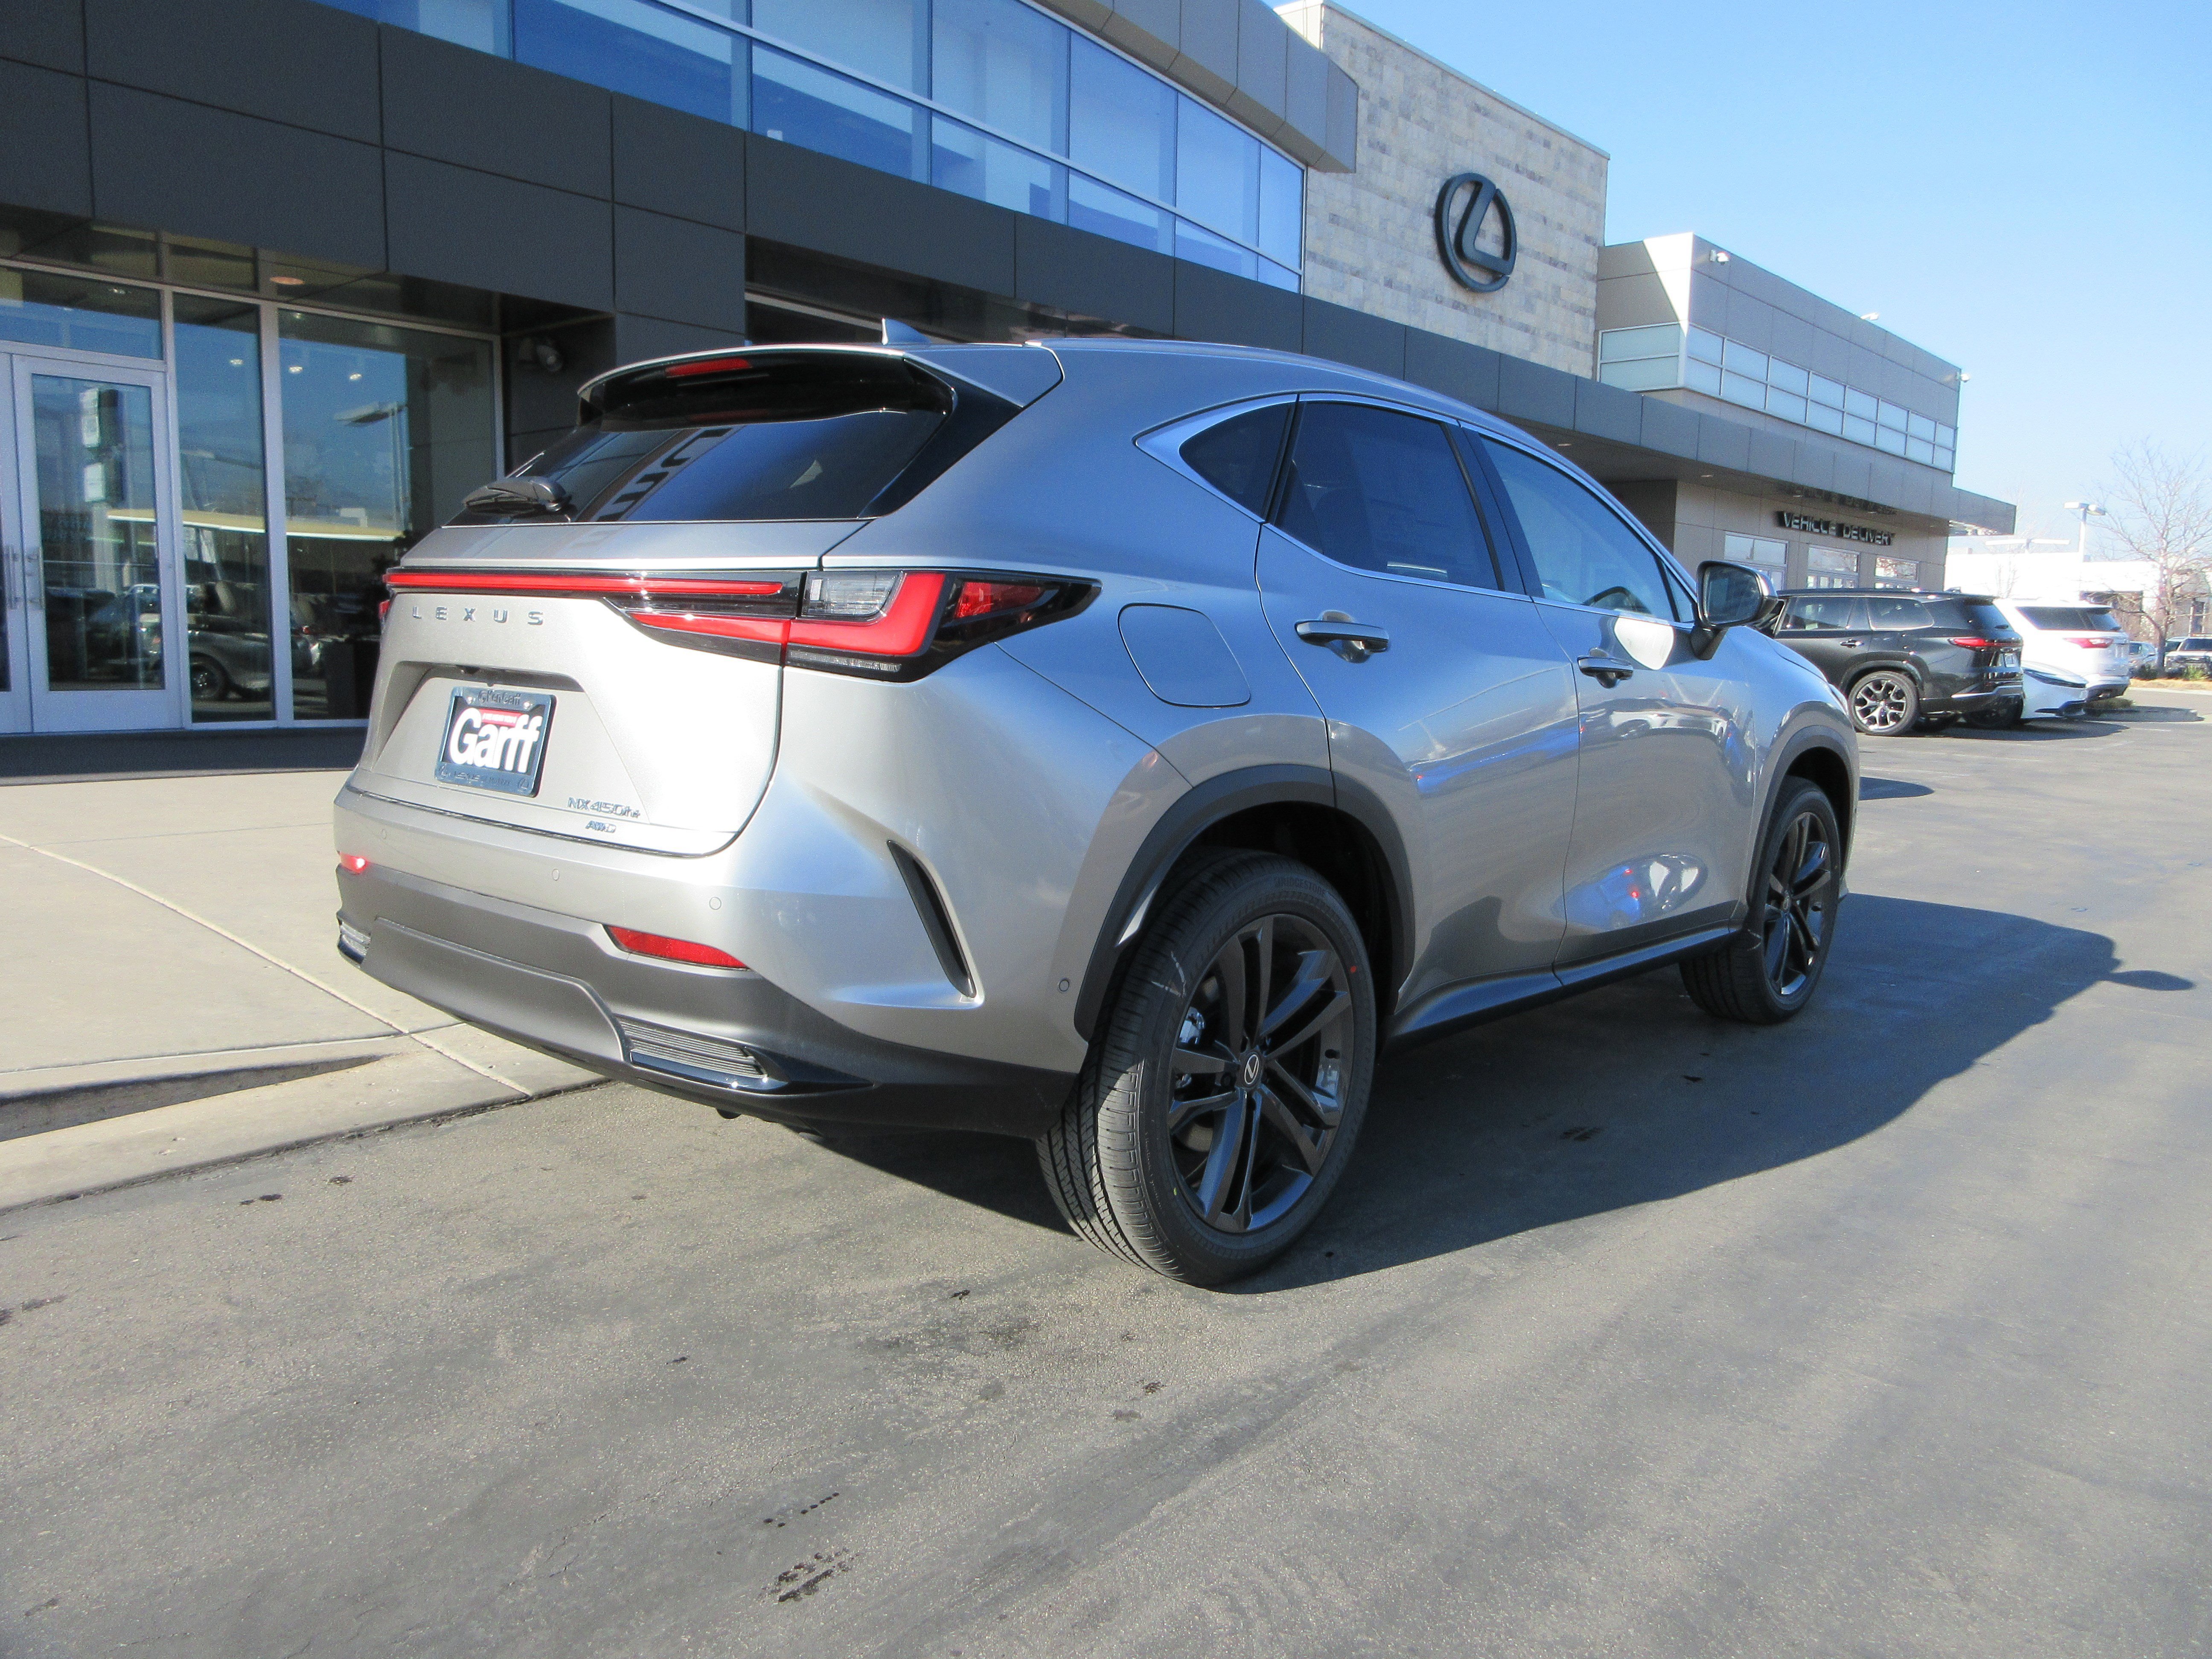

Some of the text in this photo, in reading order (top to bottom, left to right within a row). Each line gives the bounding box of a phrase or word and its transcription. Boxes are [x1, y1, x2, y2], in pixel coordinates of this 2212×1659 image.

[1781, 512, 1837, 536] VEHICLE
[412, 606, 544, 626] LEXUS
[449, 707, 544, 774] Garff
[585, 820, 617, 834] AWD
